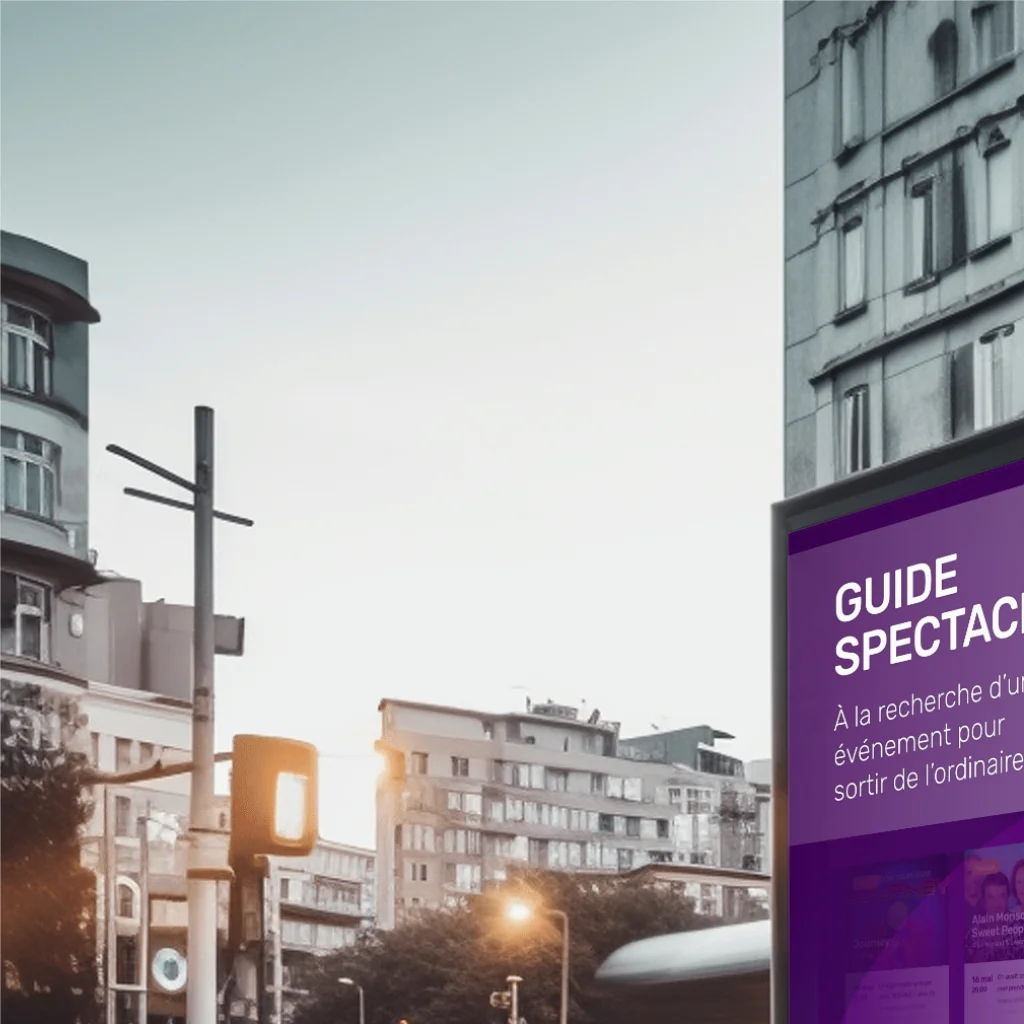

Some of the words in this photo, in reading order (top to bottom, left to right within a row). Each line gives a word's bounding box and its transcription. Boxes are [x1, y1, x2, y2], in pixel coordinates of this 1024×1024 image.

[835, 553, 958, 623] GUIDE
[833, 705, 849, 732] À
[854, 706, 871, 727] la
[878, 684, 983, 722] recherche
[834, 724, 952, 766] événement
[958, 718, 1006, 749] pour
[834, 774, 888, 802] sortir
[893, 769, 919, 792] de
[972, 913, 994, 924] Alain
[972, 926, 1000, 938] Sweet
[972, 975, 980, 983] 16
[980, 974, 993, 983] mai
